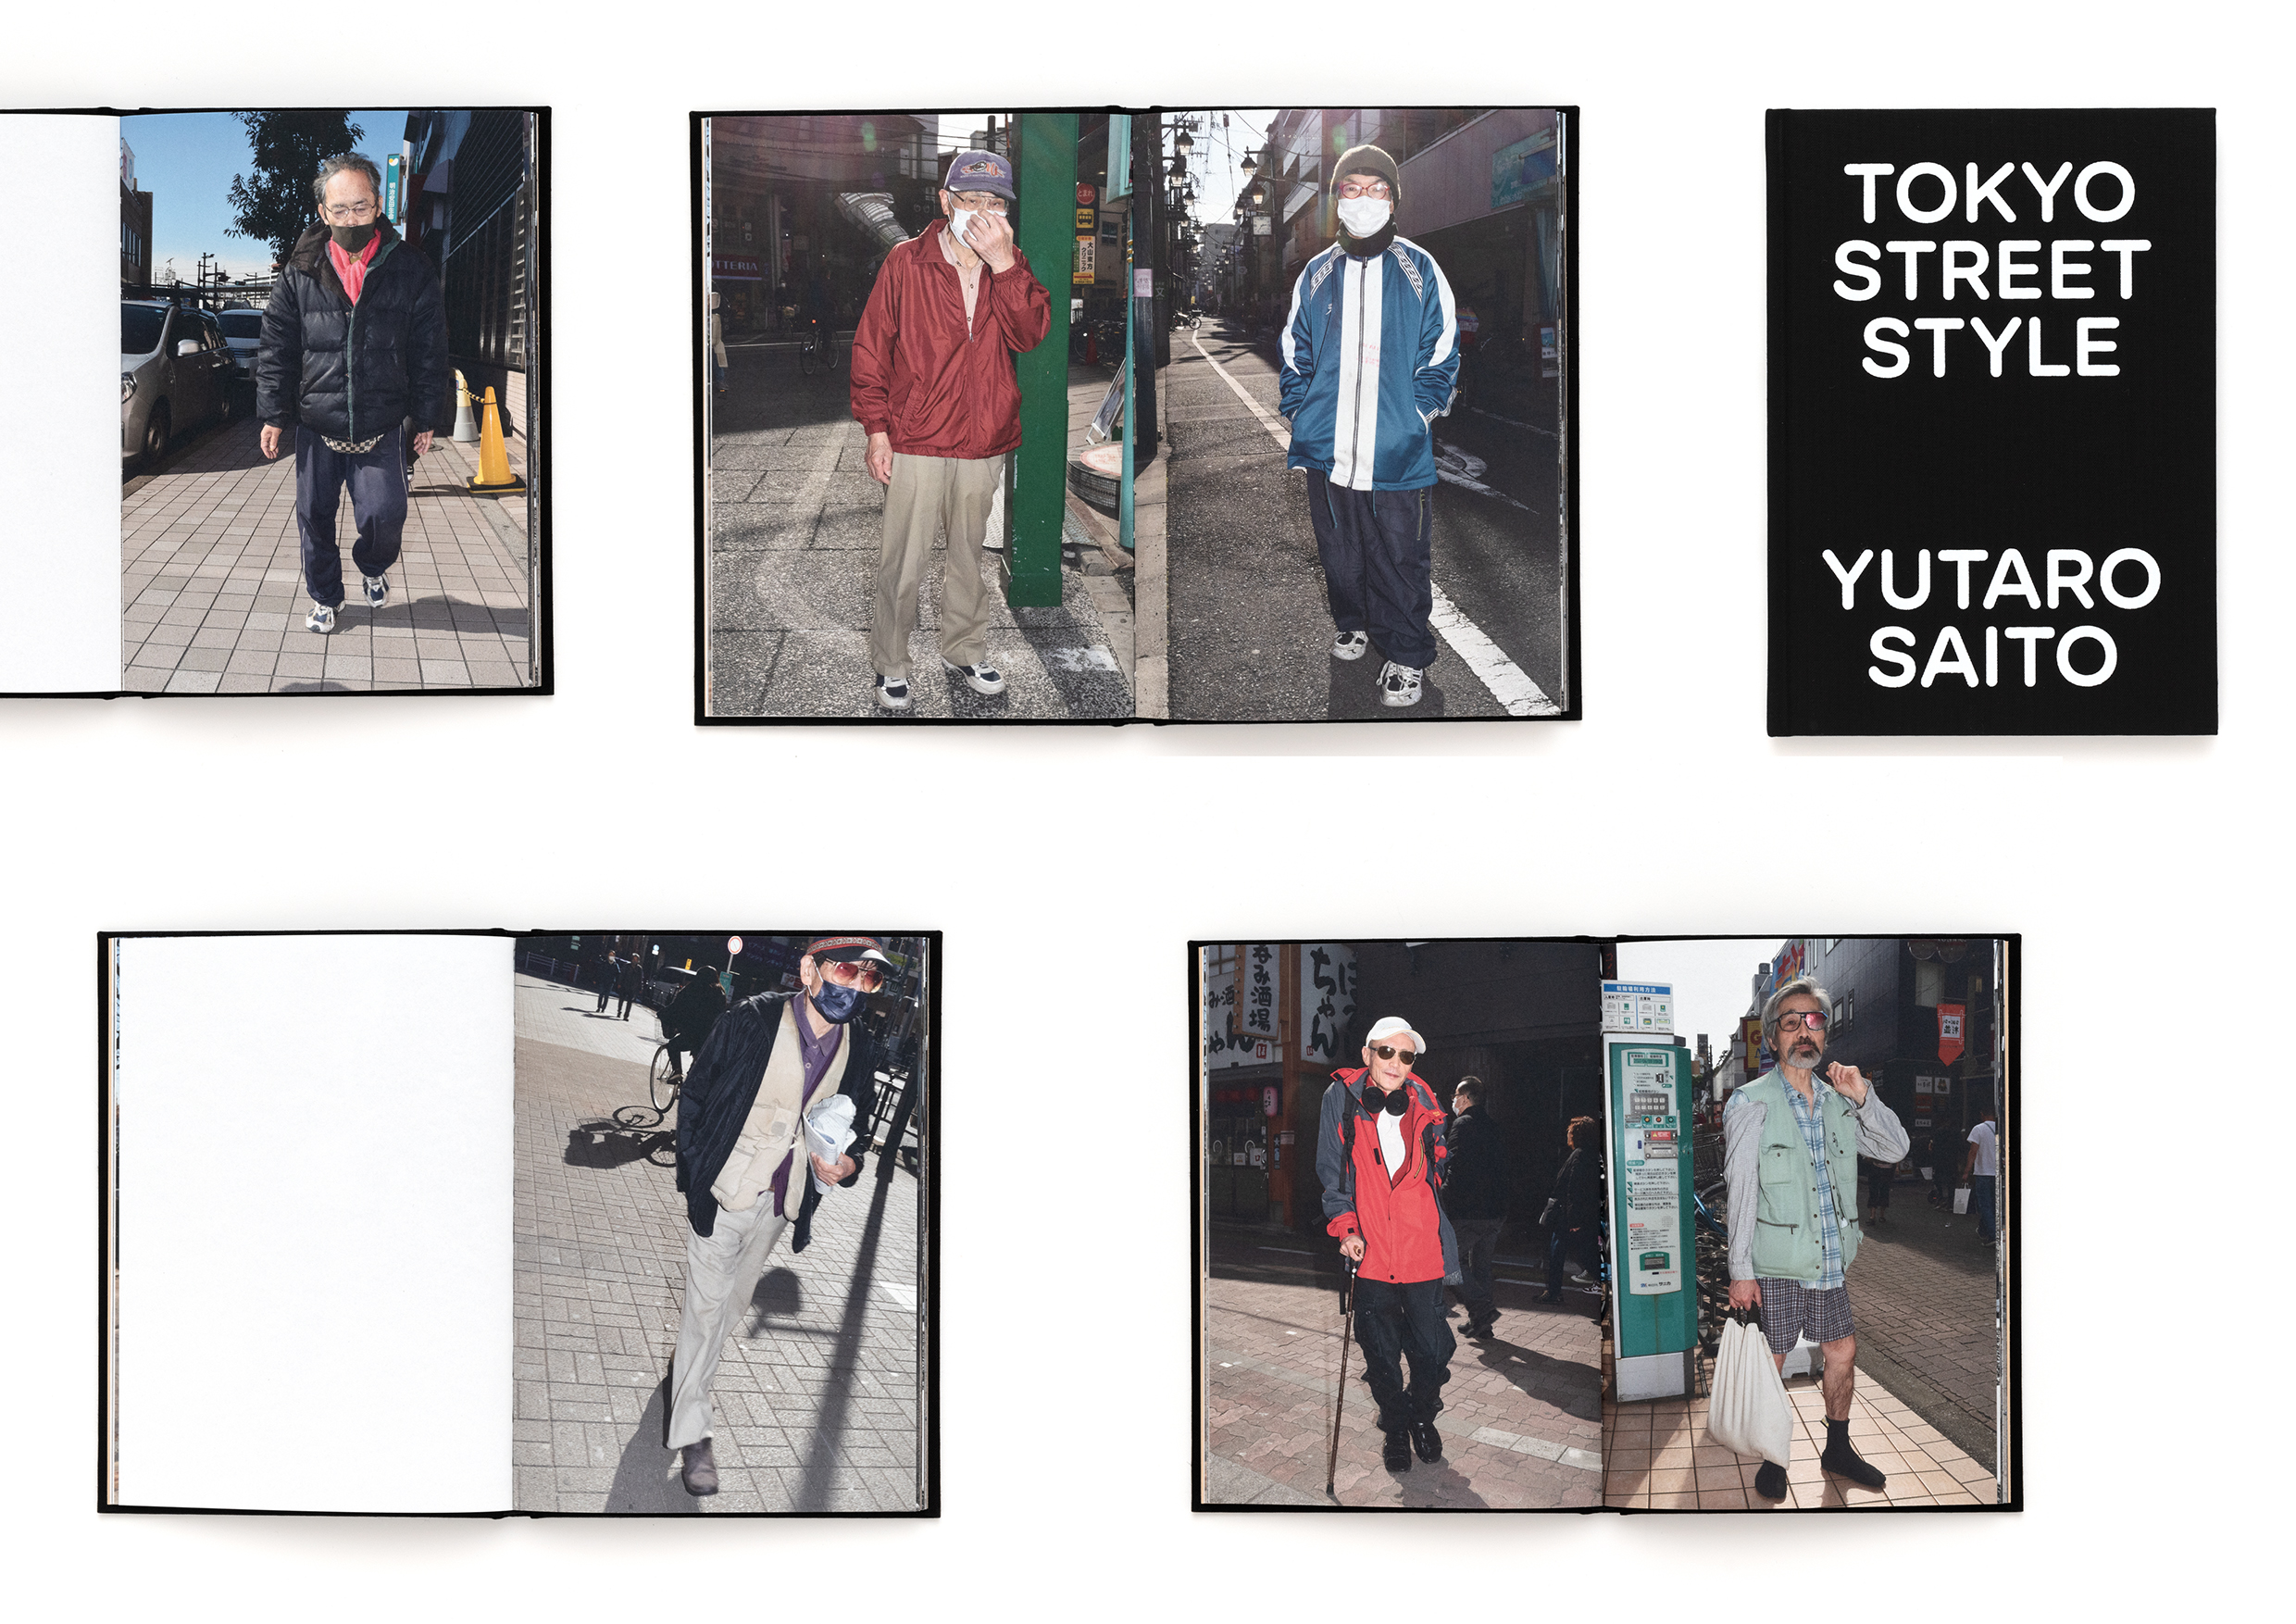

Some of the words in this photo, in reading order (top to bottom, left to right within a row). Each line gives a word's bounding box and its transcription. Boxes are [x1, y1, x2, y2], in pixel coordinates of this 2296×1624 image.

[1844, 161, 2135, 223] TOKYO
[712, 260, 758, 271] TTERIA
[1833, 240, 2152, 301] STREET
[1863, 317, 2120, 378] STYLE
[1822, 548, 2161, 610] YUTARO
[1868, 626, 2117, 688] SAITO
